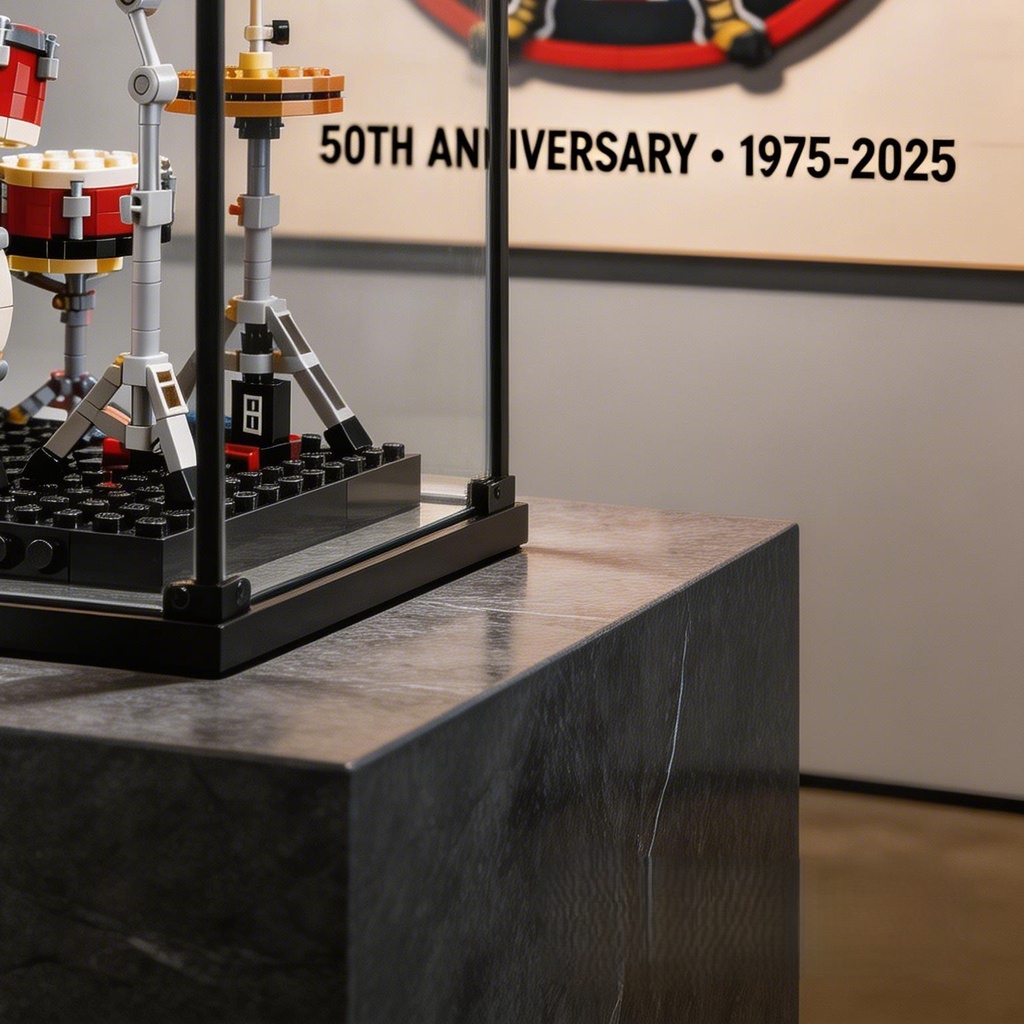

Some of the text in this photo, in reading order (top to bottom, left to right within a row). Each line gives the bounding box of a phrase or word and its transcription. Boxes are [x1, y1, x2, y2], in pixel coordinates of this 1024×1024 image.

[320, 124, 414, 167] 50TH
[427, 126, 698, 175] ANIVERSARY
[740, 134, 957, 183] 1975-2025
